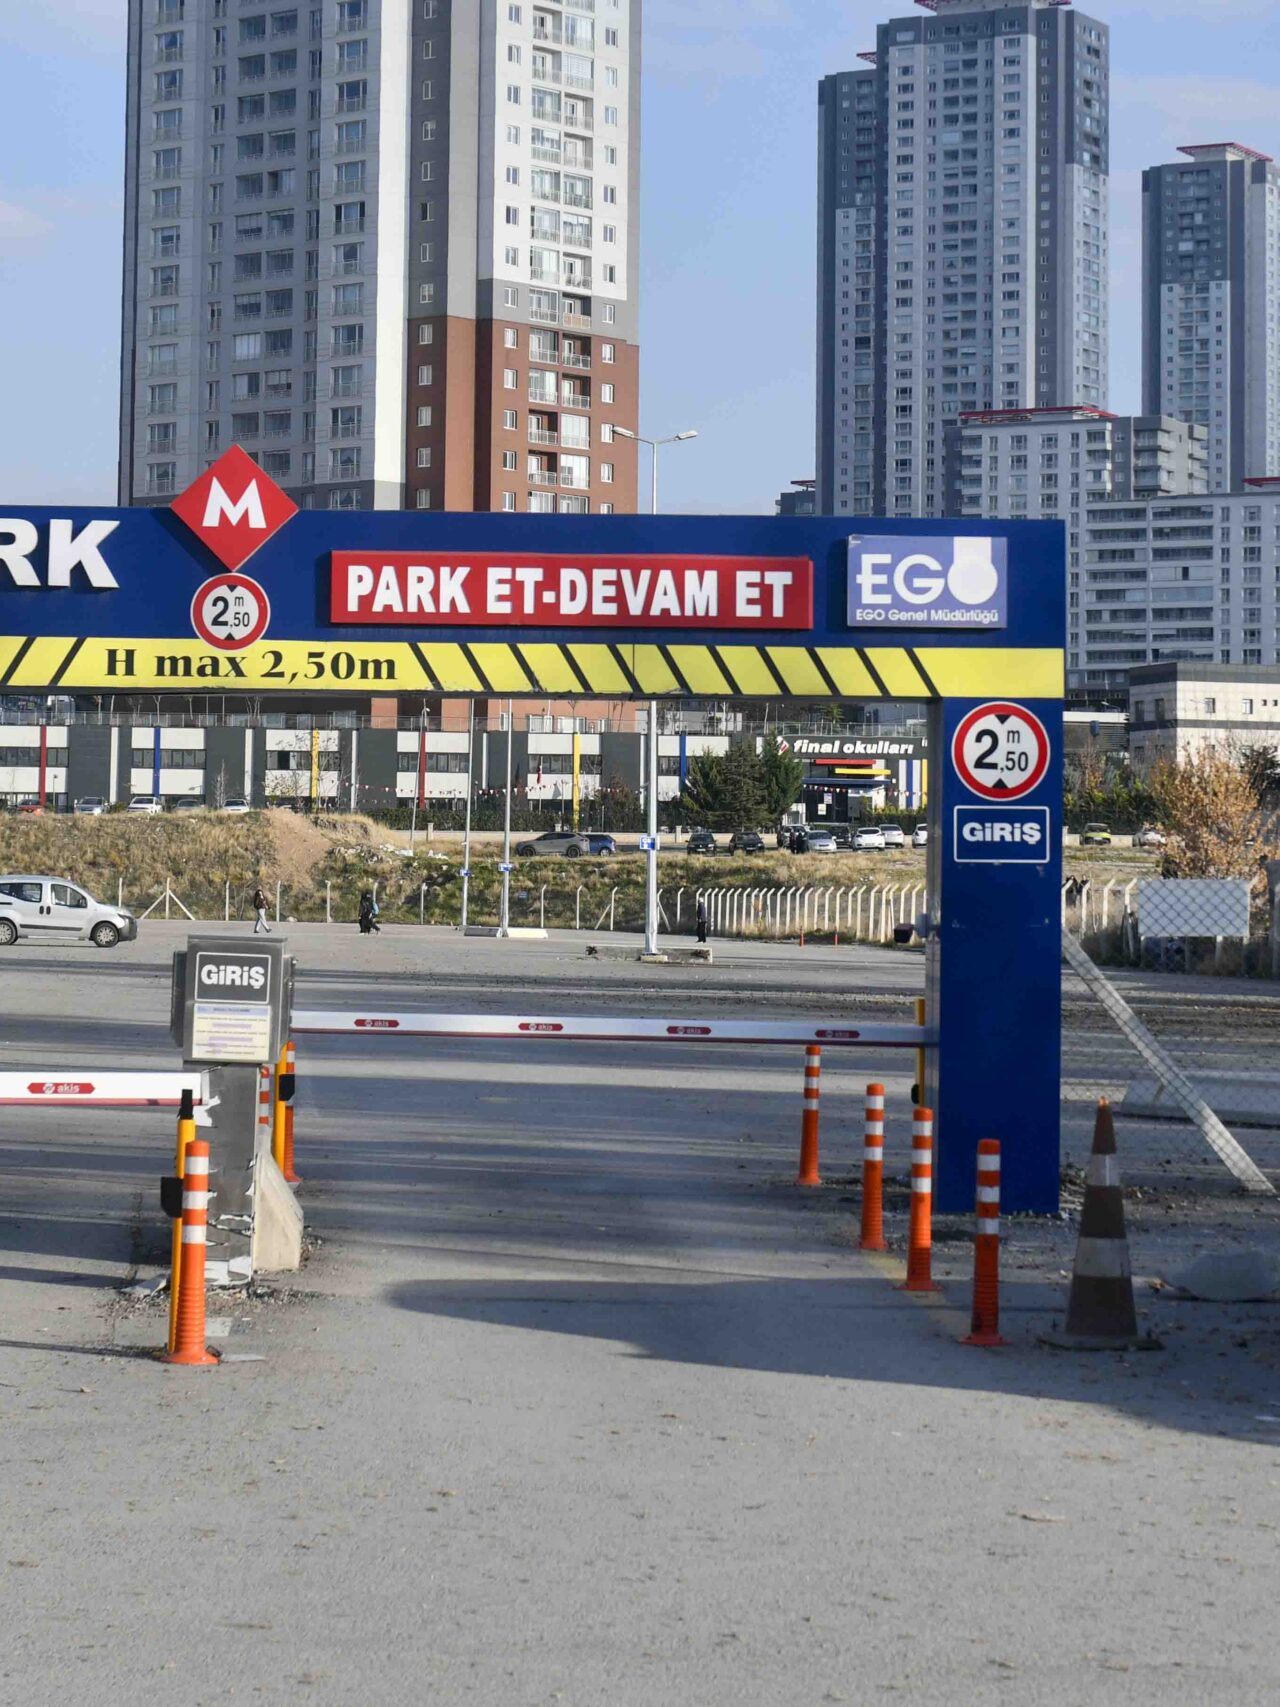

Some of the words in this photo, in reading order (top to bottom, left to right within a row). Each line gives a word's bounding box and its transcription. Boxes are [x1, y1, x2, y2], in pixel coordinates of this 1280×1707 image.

[202, 476, 267, 528] M
[347, 565, 470, 613] PARK
[487, 567, 718, 617] ET-DEVAM
[735, 571, 793, 618] ET
[856, 609, 885, 621] EGO
[888, 609, 927, 621] Genel
[931, 609, 998, 624] Müdürlüğü
[105, 649, 136, 676] H
[154, 654, 247, 679] max
[260, 650, 397, 683] 2,50m
[793, 739, 840, 754] final
[843, 740, 914, 755] okulları
[57, 1083, 80, 1093] akis
